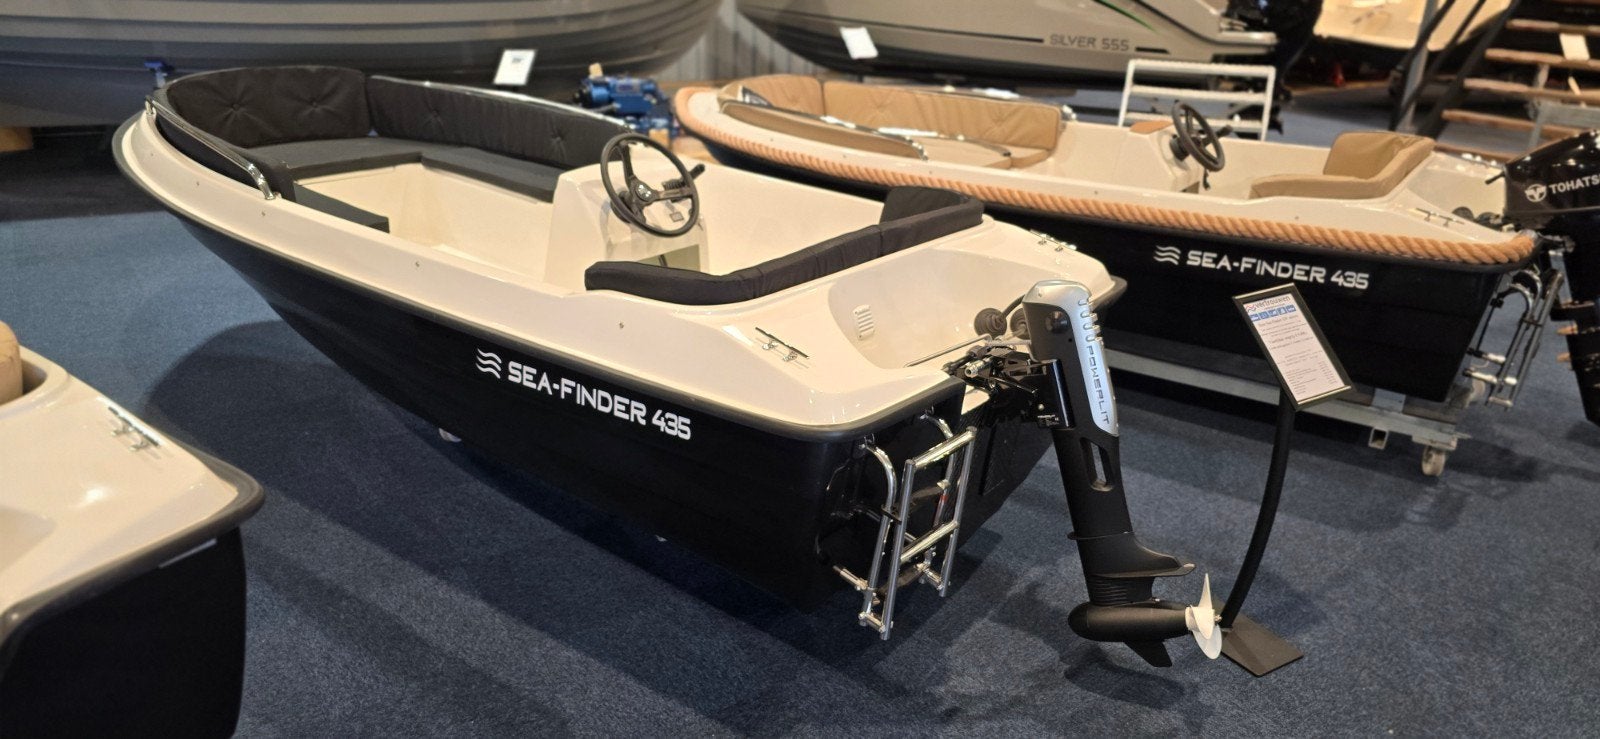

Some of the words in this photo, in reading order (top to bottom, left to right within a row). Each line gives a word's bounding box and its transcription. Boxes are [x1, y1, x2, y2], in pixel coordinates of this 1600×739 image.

[1050, 34, 1096, 49] SILVER
[1101, 38, 1129, 51] 555
[1549, 174, 1600, 194] TOHATS
[1186, 250, 1326, 283] SEA-FINDER
[1331, 270, 1370, 290] 435
[508, 361, 647, 426] SEA-FINDER
[651, 410, 692, 441] 435
[1086, 345, 1110, 424] POWERLIT
